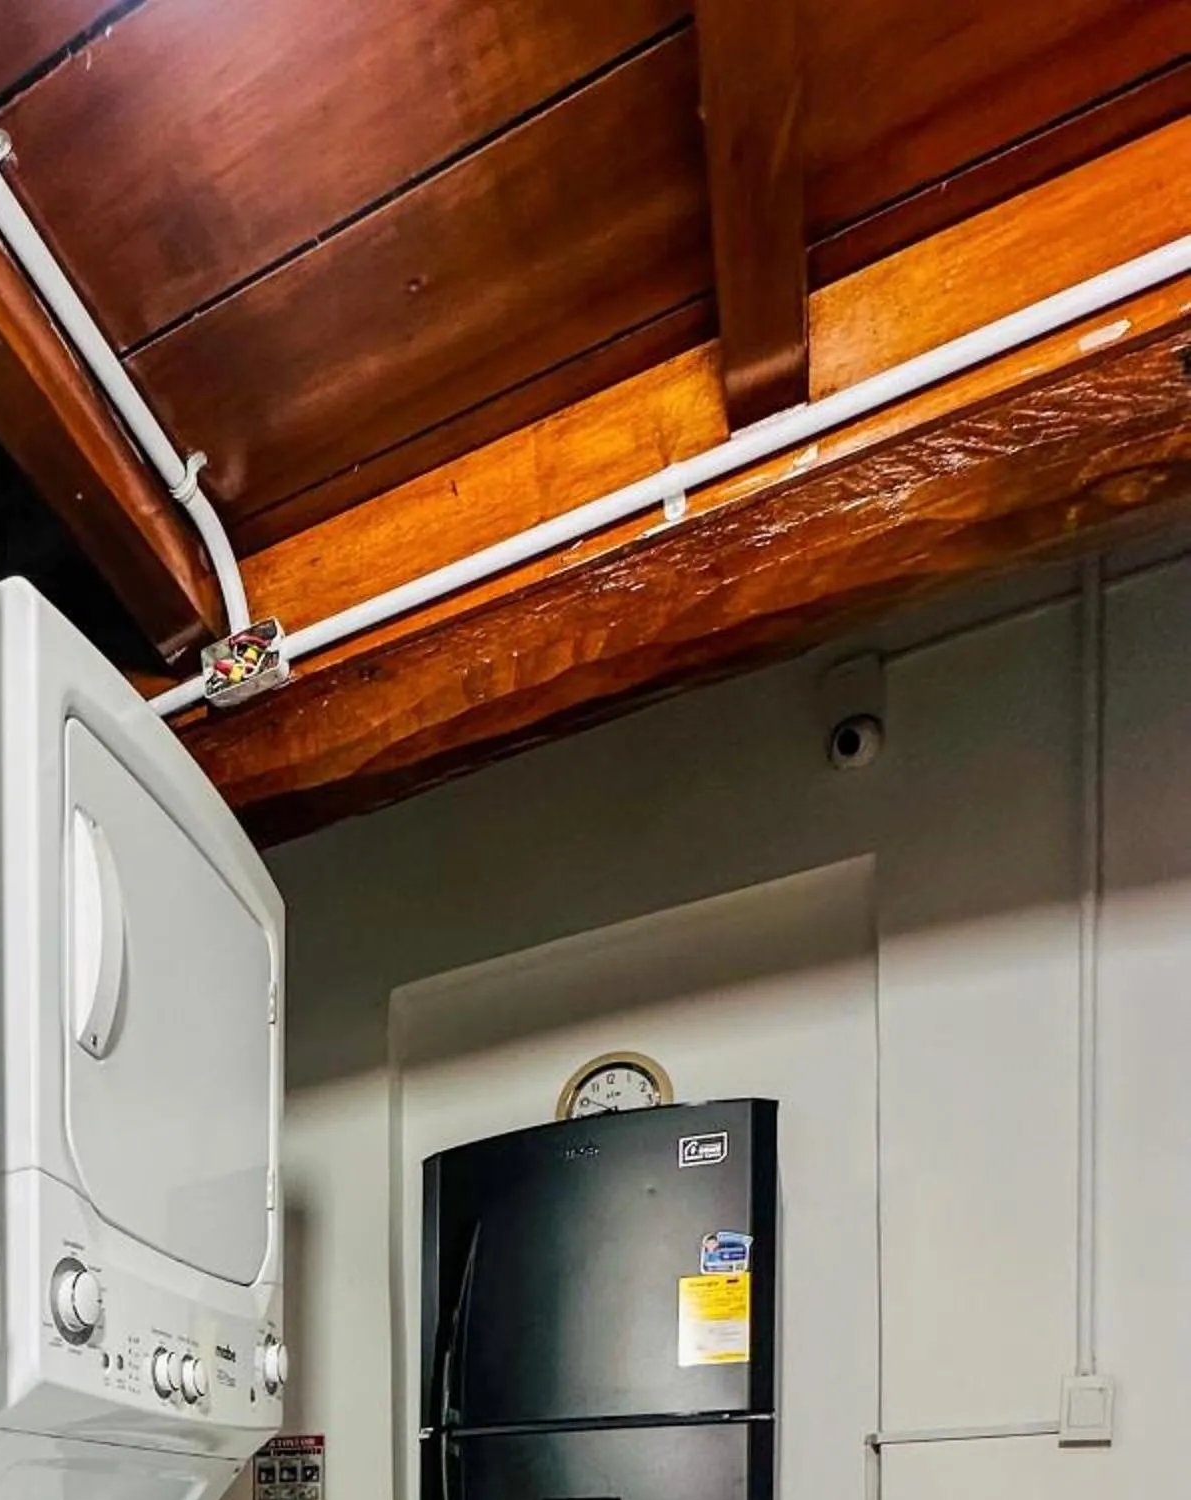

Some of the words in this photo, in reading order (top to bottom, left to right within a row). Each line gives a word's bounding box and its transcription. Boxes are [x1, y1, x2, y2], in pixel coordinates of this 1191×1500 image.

[606, 1072, 616, 1084] 12
[591, 1083, 600, 1093] 11
[639, 1081, 647, 1093] 2
